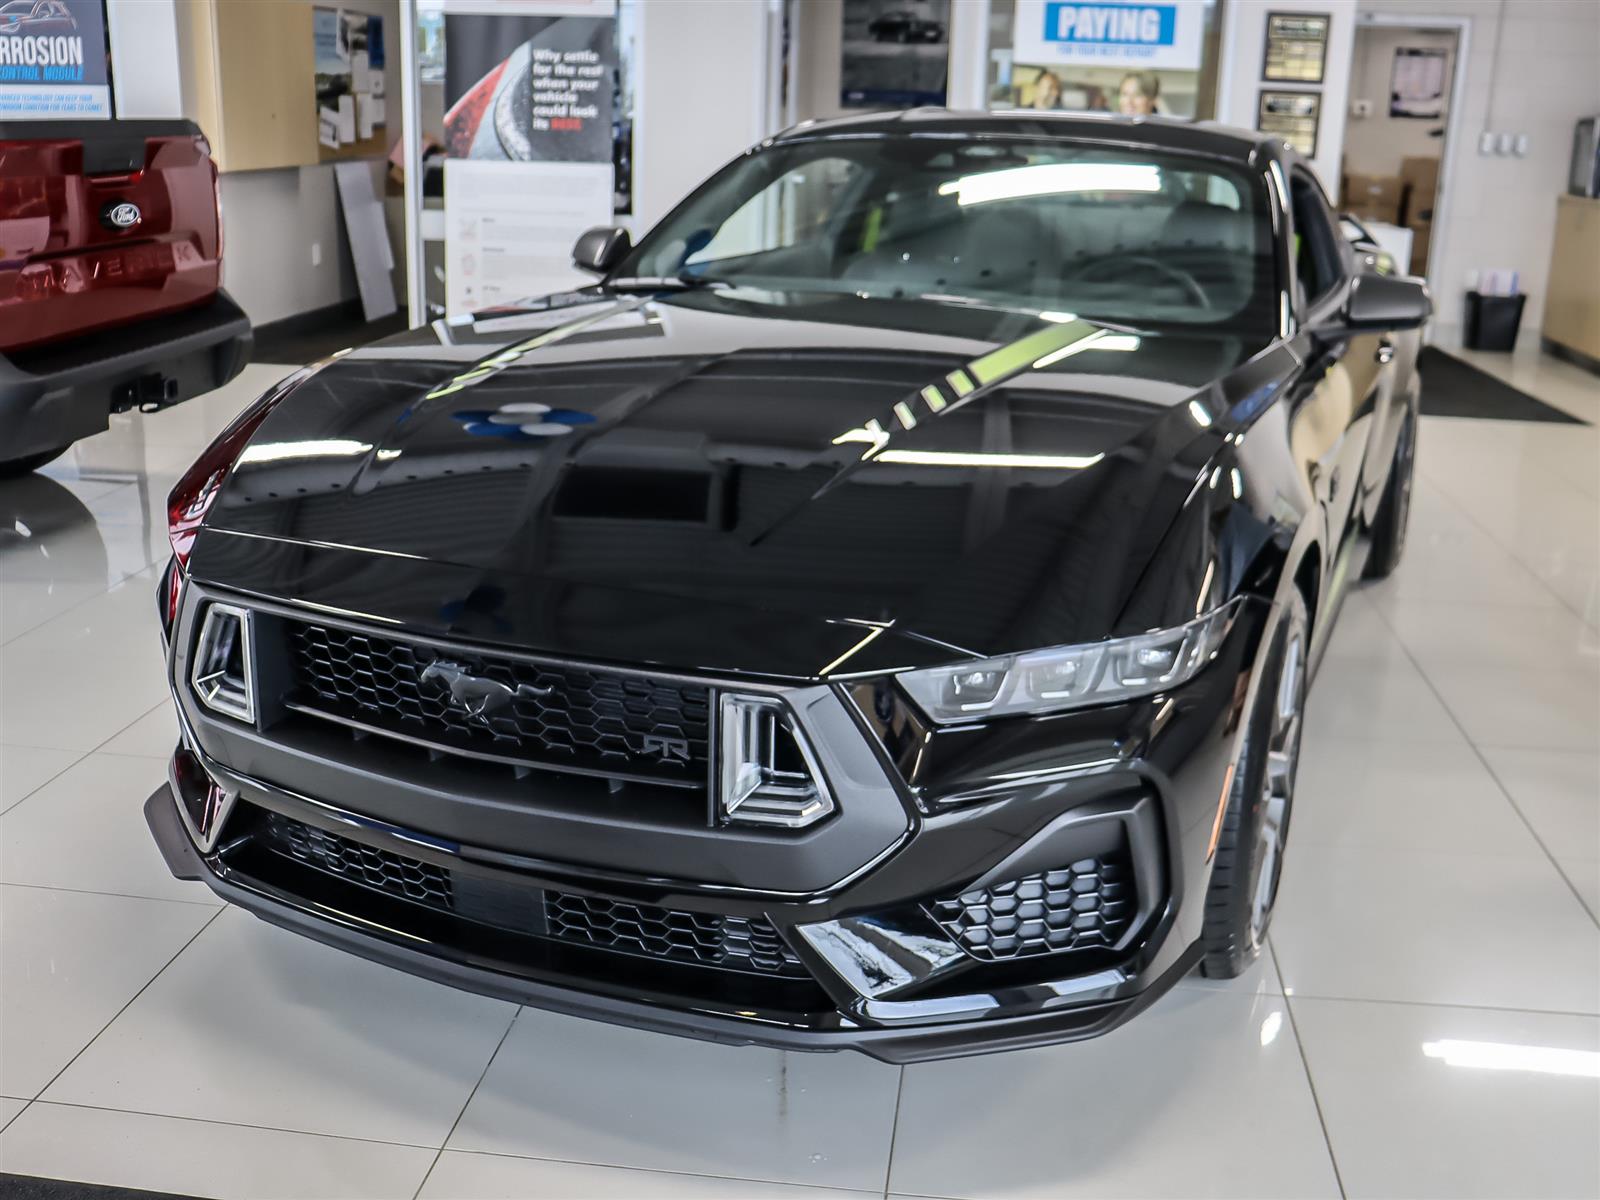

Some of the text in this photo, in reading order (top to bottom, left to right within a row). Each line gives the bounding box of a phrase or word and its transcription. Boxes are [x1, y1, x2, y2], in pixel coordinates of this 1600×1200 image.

[1057, 6, 1161, 42] PAYING
[533, 49, 599, 63] Why settle
[43, 65, 83, 80] MODULE
[533, 63, 604, 77] for the rest
[533, 78, 599, 92] when your
[533, 91, 578, 103] vehicle
[533, 104, 598, 118] could look
[533, 117, 549, 130] its
